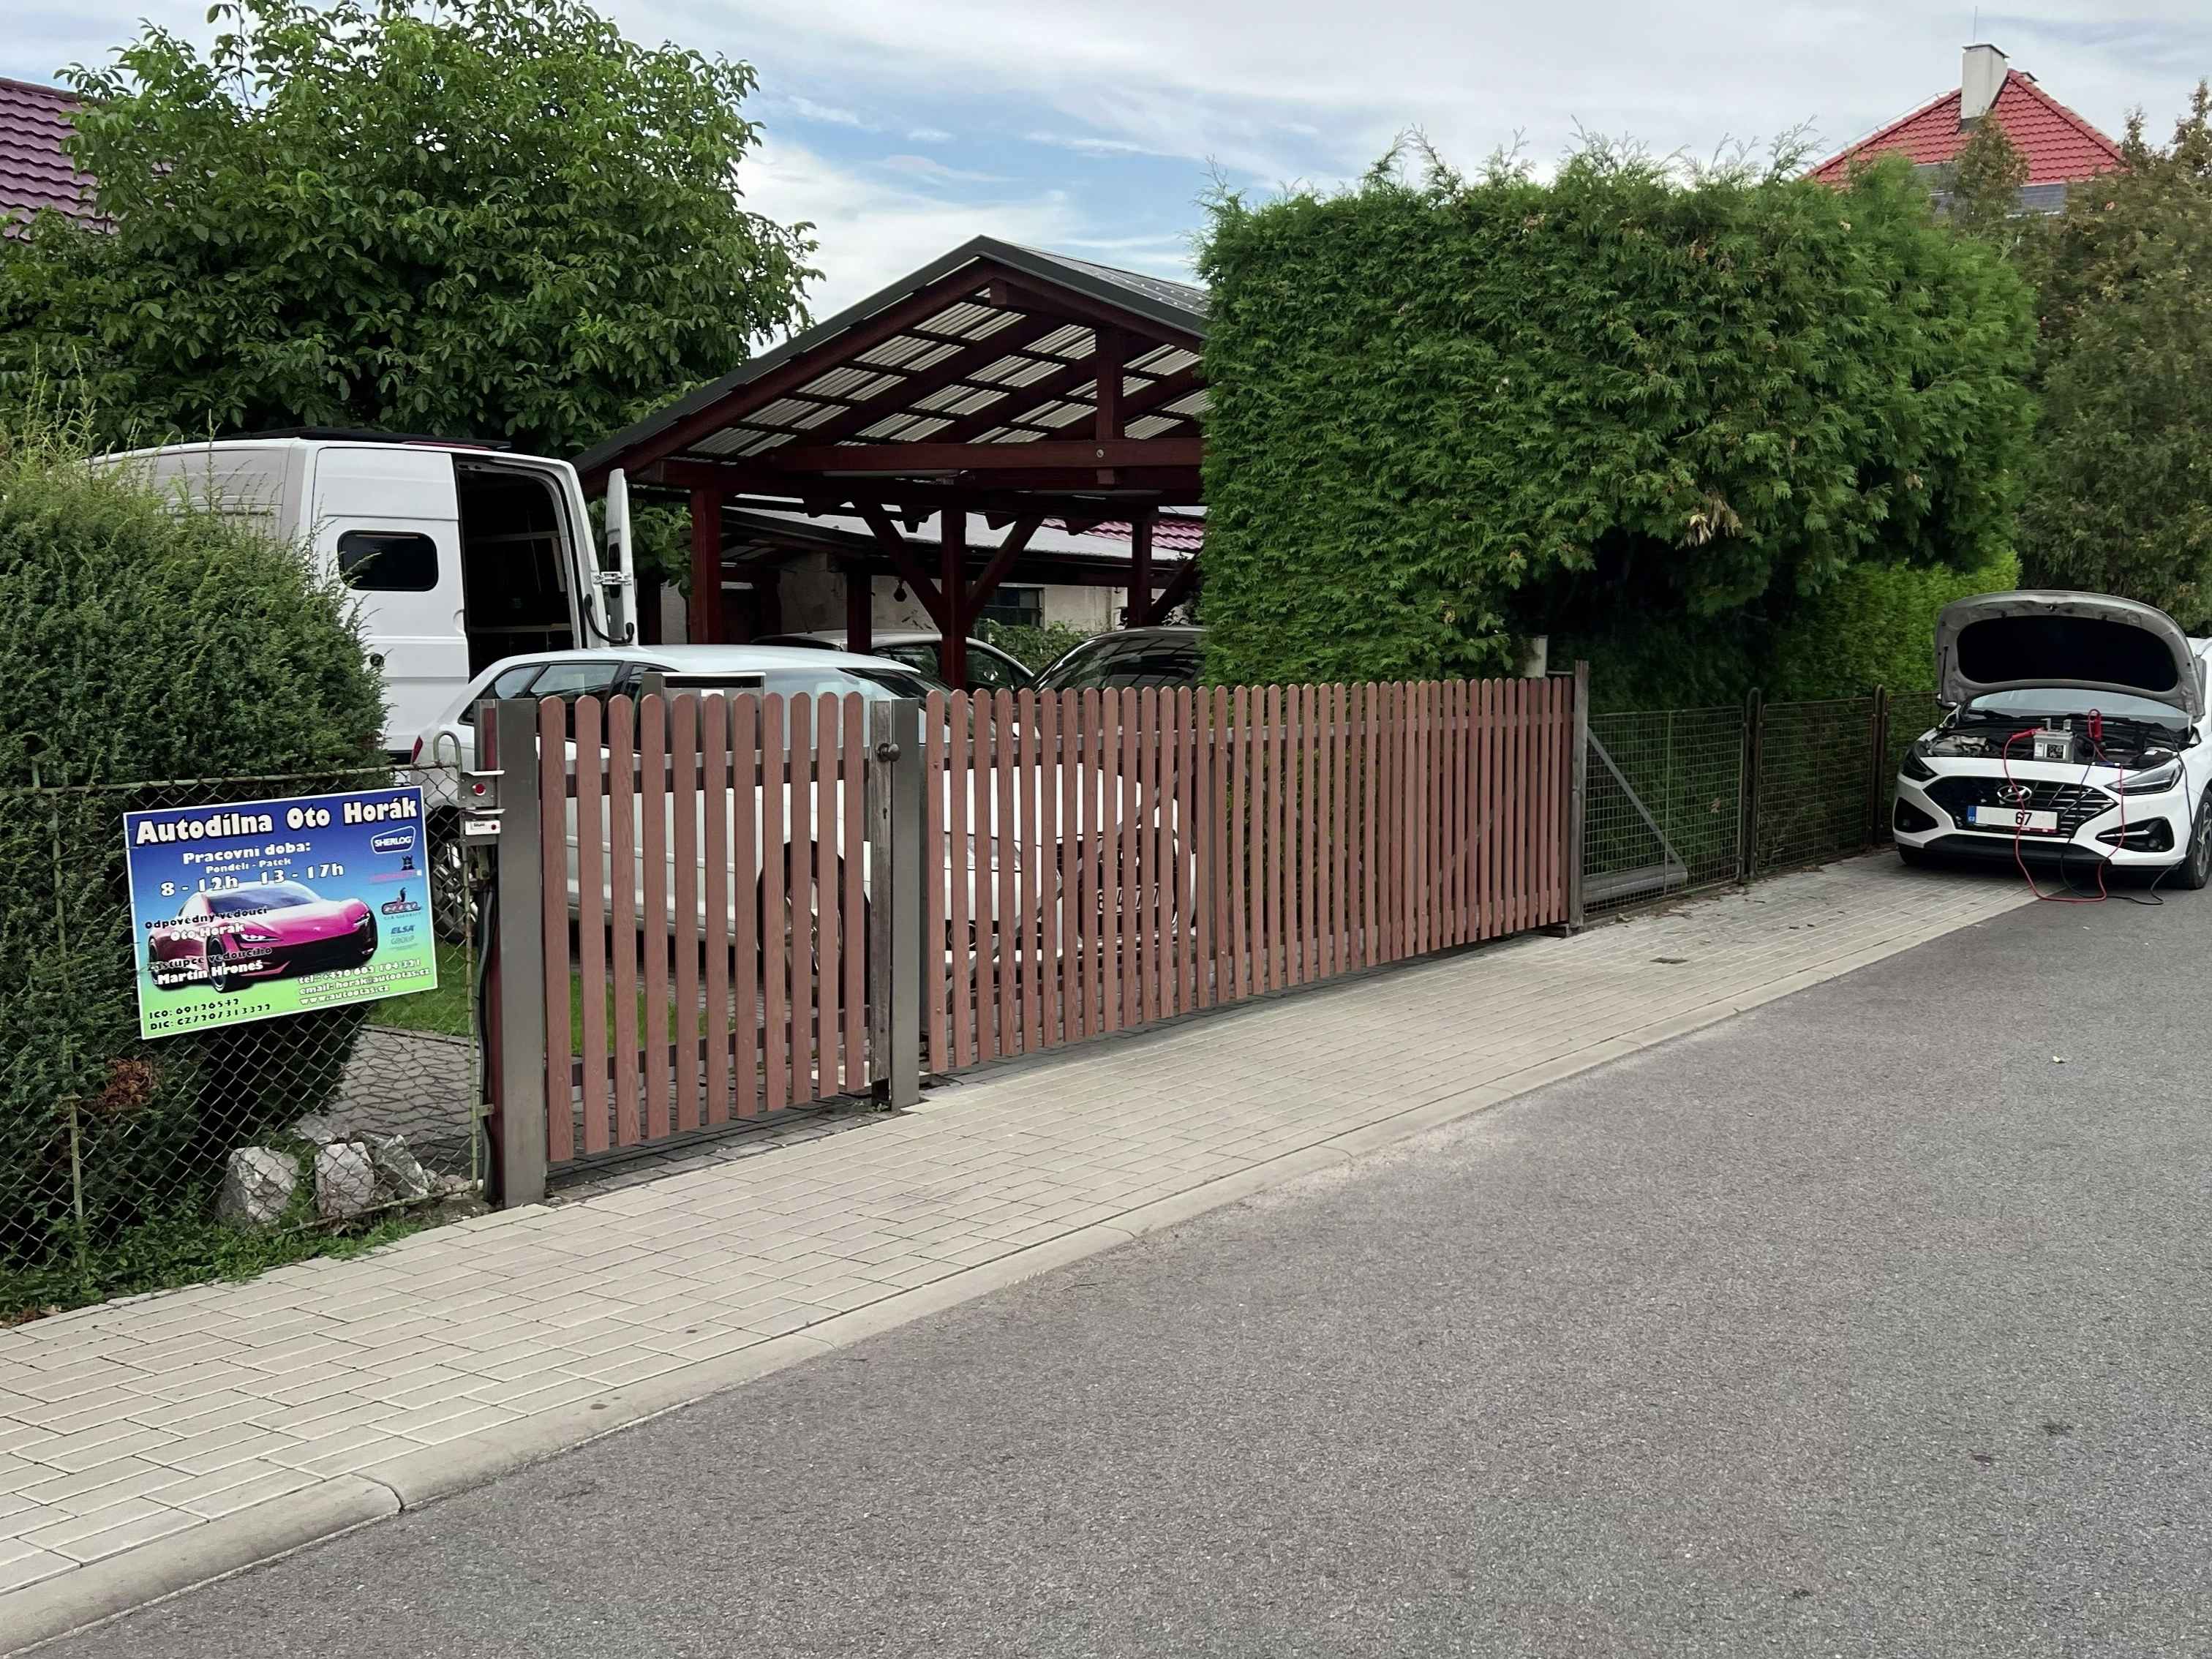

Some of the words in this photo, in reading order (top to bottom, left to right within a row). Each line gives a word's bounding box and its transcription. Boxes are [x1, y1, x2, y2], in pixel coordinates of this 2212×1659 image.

[135, 812, 274, 845] Autodílna
[286, 807, 331, 830] Oto
[343, 797, 418, 824] Horák
[2015, 811, 2032, 825] 67
[374, 835, 413, 848] SHERLOG
[264, 842, 310, 856] doba:
[160, 881, 176, 897] 8
[260, 869, 285, 885] 13
[306, 862, 345, 879] 17h
[170, 929, 197, 941] Oto
[157, 969, 209, 985] Martin
